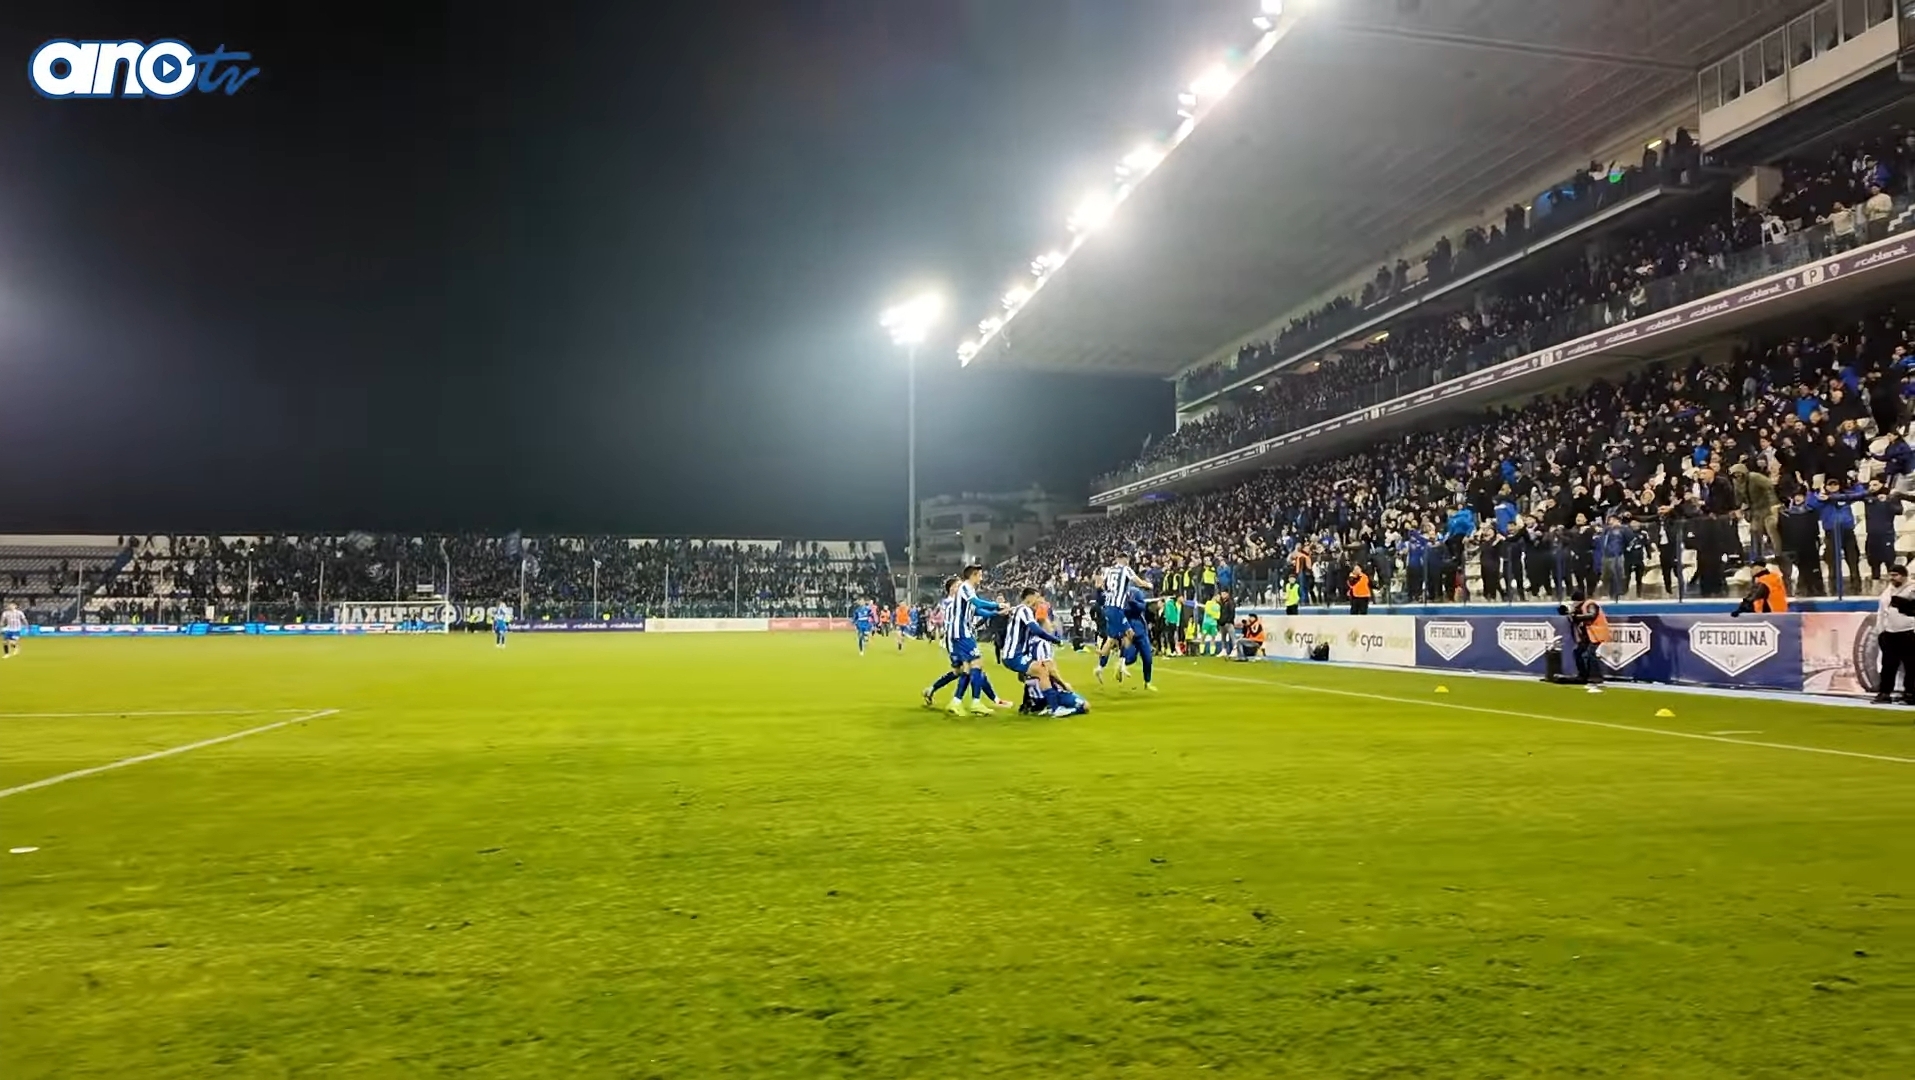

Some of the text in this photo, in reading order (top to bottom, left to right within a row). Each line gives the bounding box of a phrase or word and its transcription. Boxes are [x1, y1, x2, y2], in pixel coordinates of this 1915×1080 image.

[1430, 626, 1466, 638] PETROLINA
[1504, 628, 1547, 641] PETROLINA
[1612, 629, 1643, 643] OLINA
[1699, 630, 1768, 646] PETROLINA
